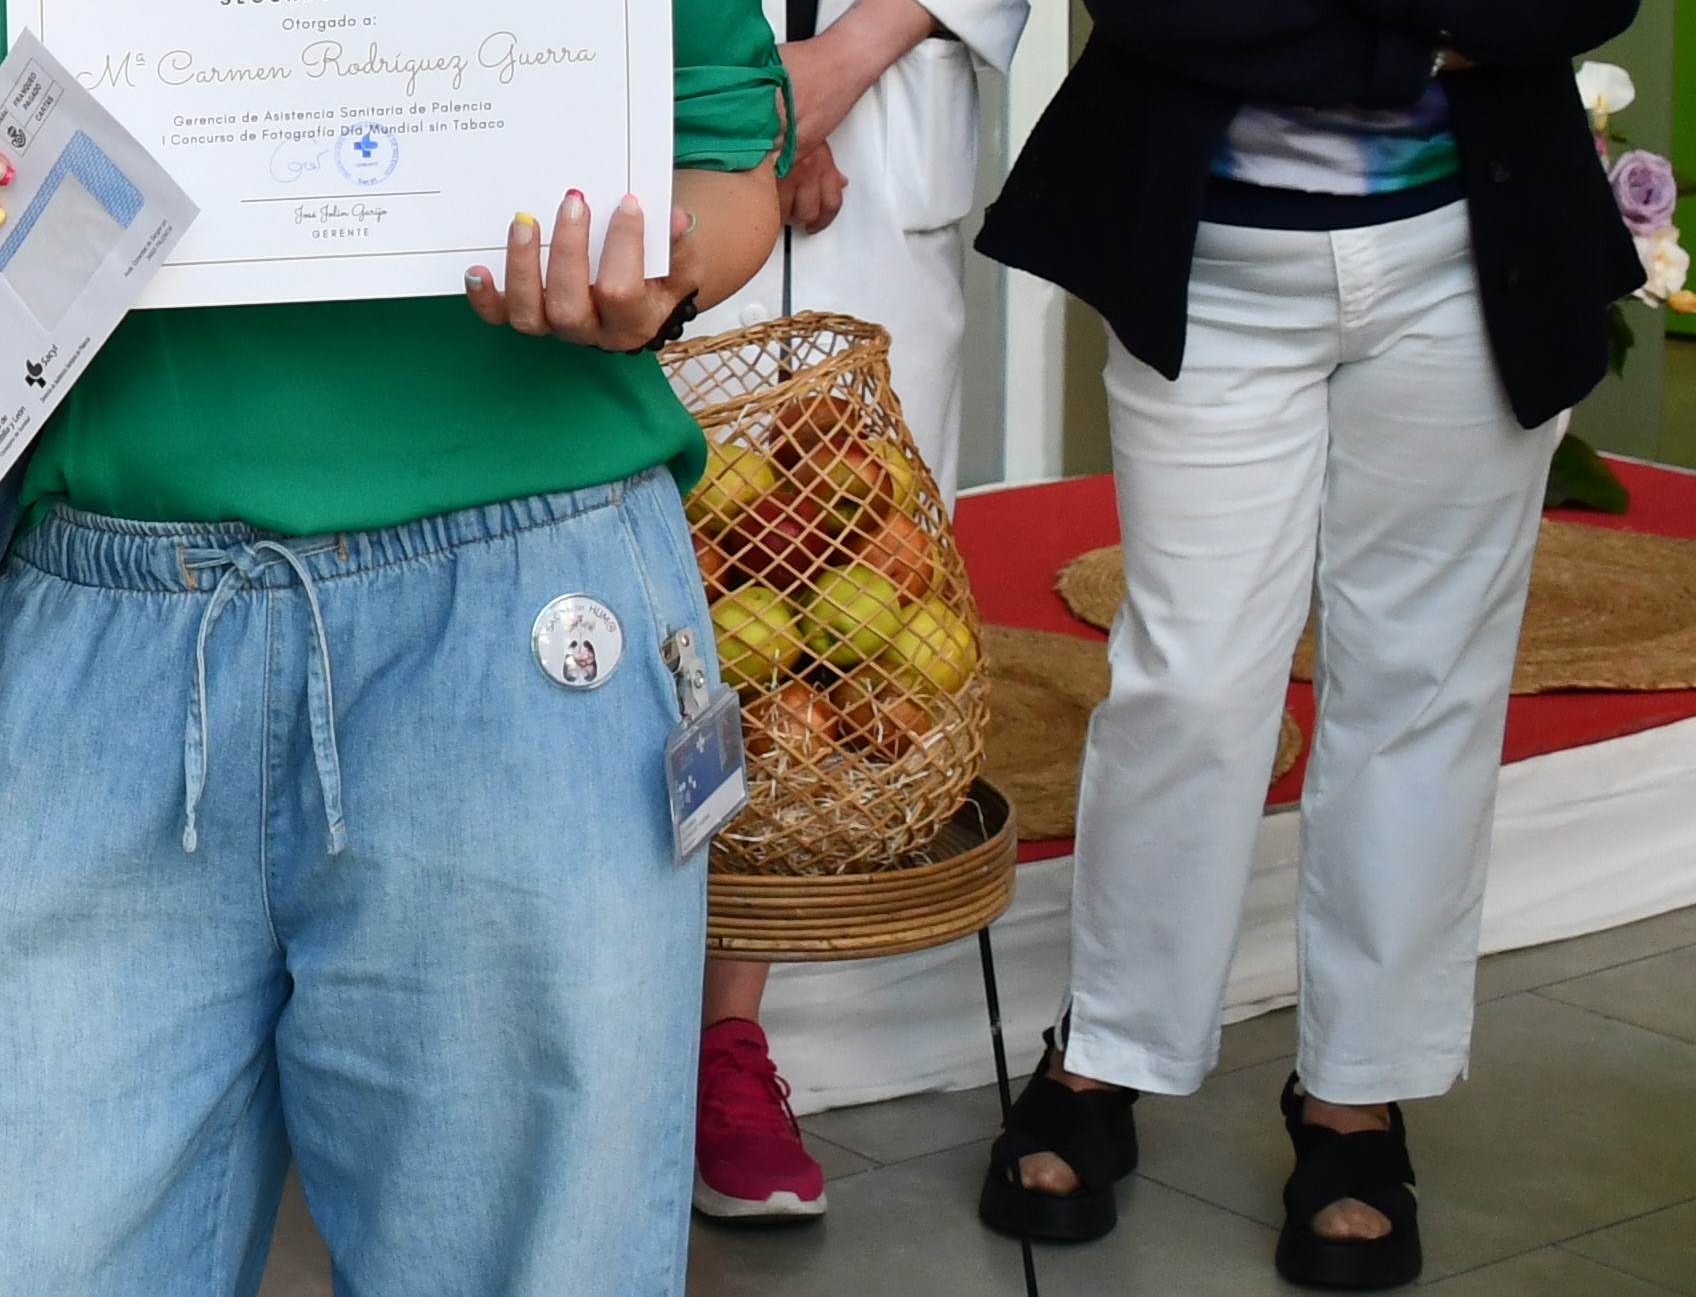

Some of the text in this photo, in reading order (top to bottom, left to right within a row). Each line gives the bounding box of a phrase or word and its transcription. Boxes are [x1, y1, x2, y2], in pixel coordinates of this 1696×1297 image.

[282, 15, 377, 33] Otorgado a:
[157, 50, 292, 86] Carmen
[301, 40, 469, 97] Rodríguez
[477, 31, 597, 85] Guerra
[13, 72, 37, 107] FRANQUEO
[23, 83, 42, 111] PAGADO
[35, 95, 54, 122] CARTAS
[173, 100, 492, 127] Gerencia de Asistencia Sanitaria de Palencia
[170, 132, 234, 146] Concurso
[240, 130, 256, 142] de
[262, 125, 335, 143] Fotografía
[369, 120, 424, 136] Mundial
[429, 120, 448, 133] sin
[453, 118, 505, 131] Tabaco
[312, 228, 369, 239] GERENTE
[41, 343, 58, 367] Sacyl
[1, 415, 8, 424] de
[12, 406, 26, 423] León
